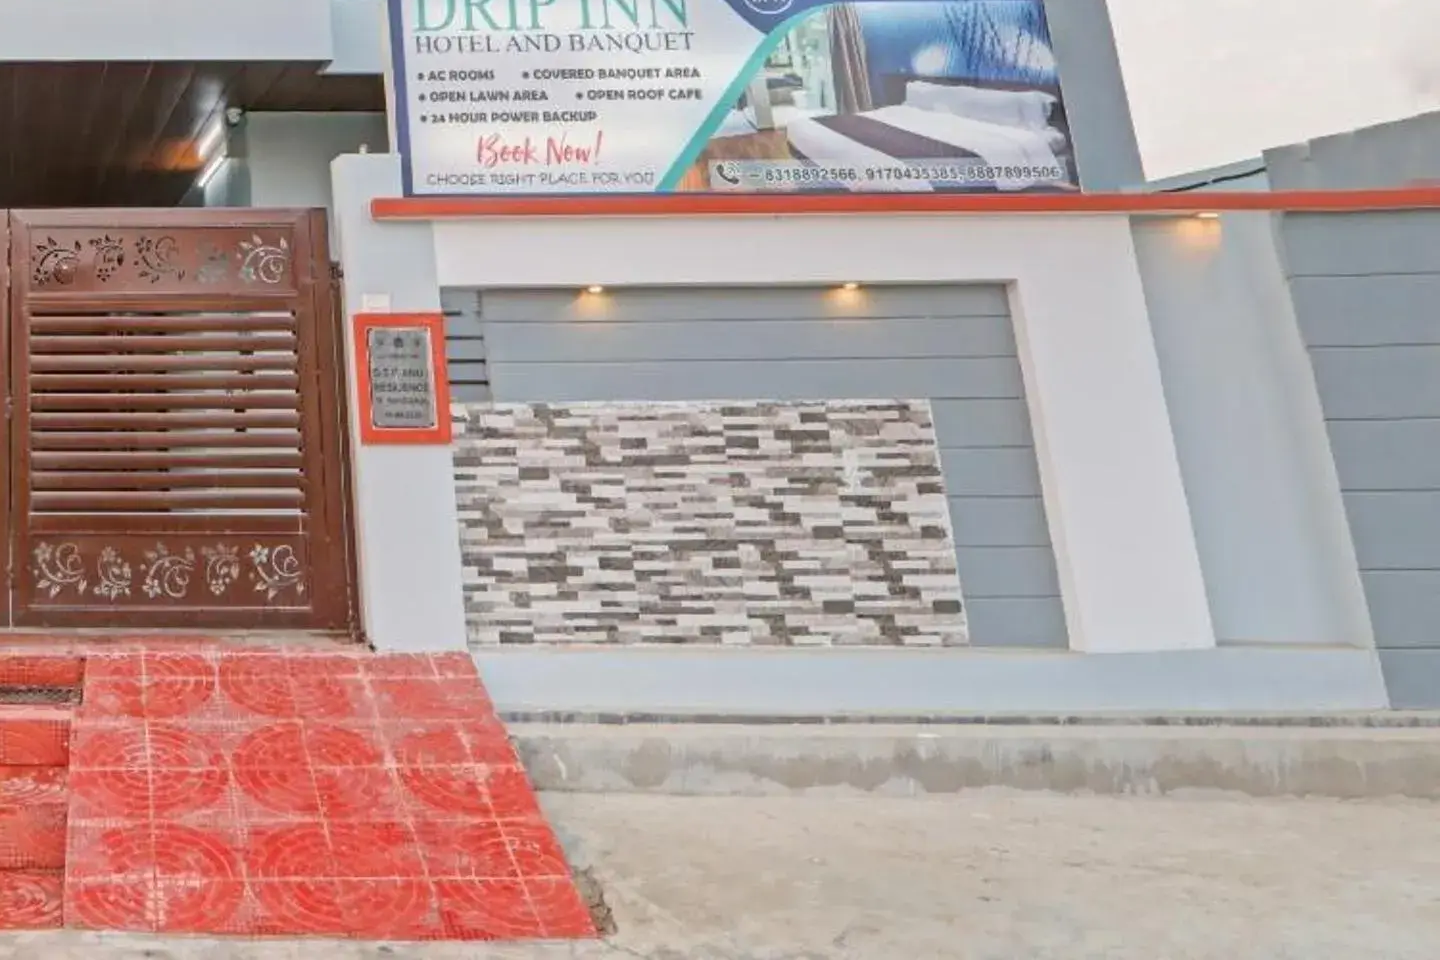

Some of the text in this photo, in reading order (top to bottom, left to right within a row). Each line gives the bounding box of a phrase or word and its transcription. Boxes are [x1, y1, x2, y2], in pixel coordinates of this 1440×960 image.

[415, 31, 694, 54] HOTEL AND BANQUET
[428, 70, 495, 81] AC ROOMS
[533, 67, 701, 81] COVERED BANQUET AREA
[429, 90, 549, 102] OPEN LAWN AREA
[587, 88, 703, 101] OPEN ROOF CAFE
[431, 110, 598, 123] 24 HOUR POWER BACKUP
[476, 129, 603, 169] Book Now!
[426, 171, 655, 186] CHOOSE RIGHT PLACE FOR YOU
